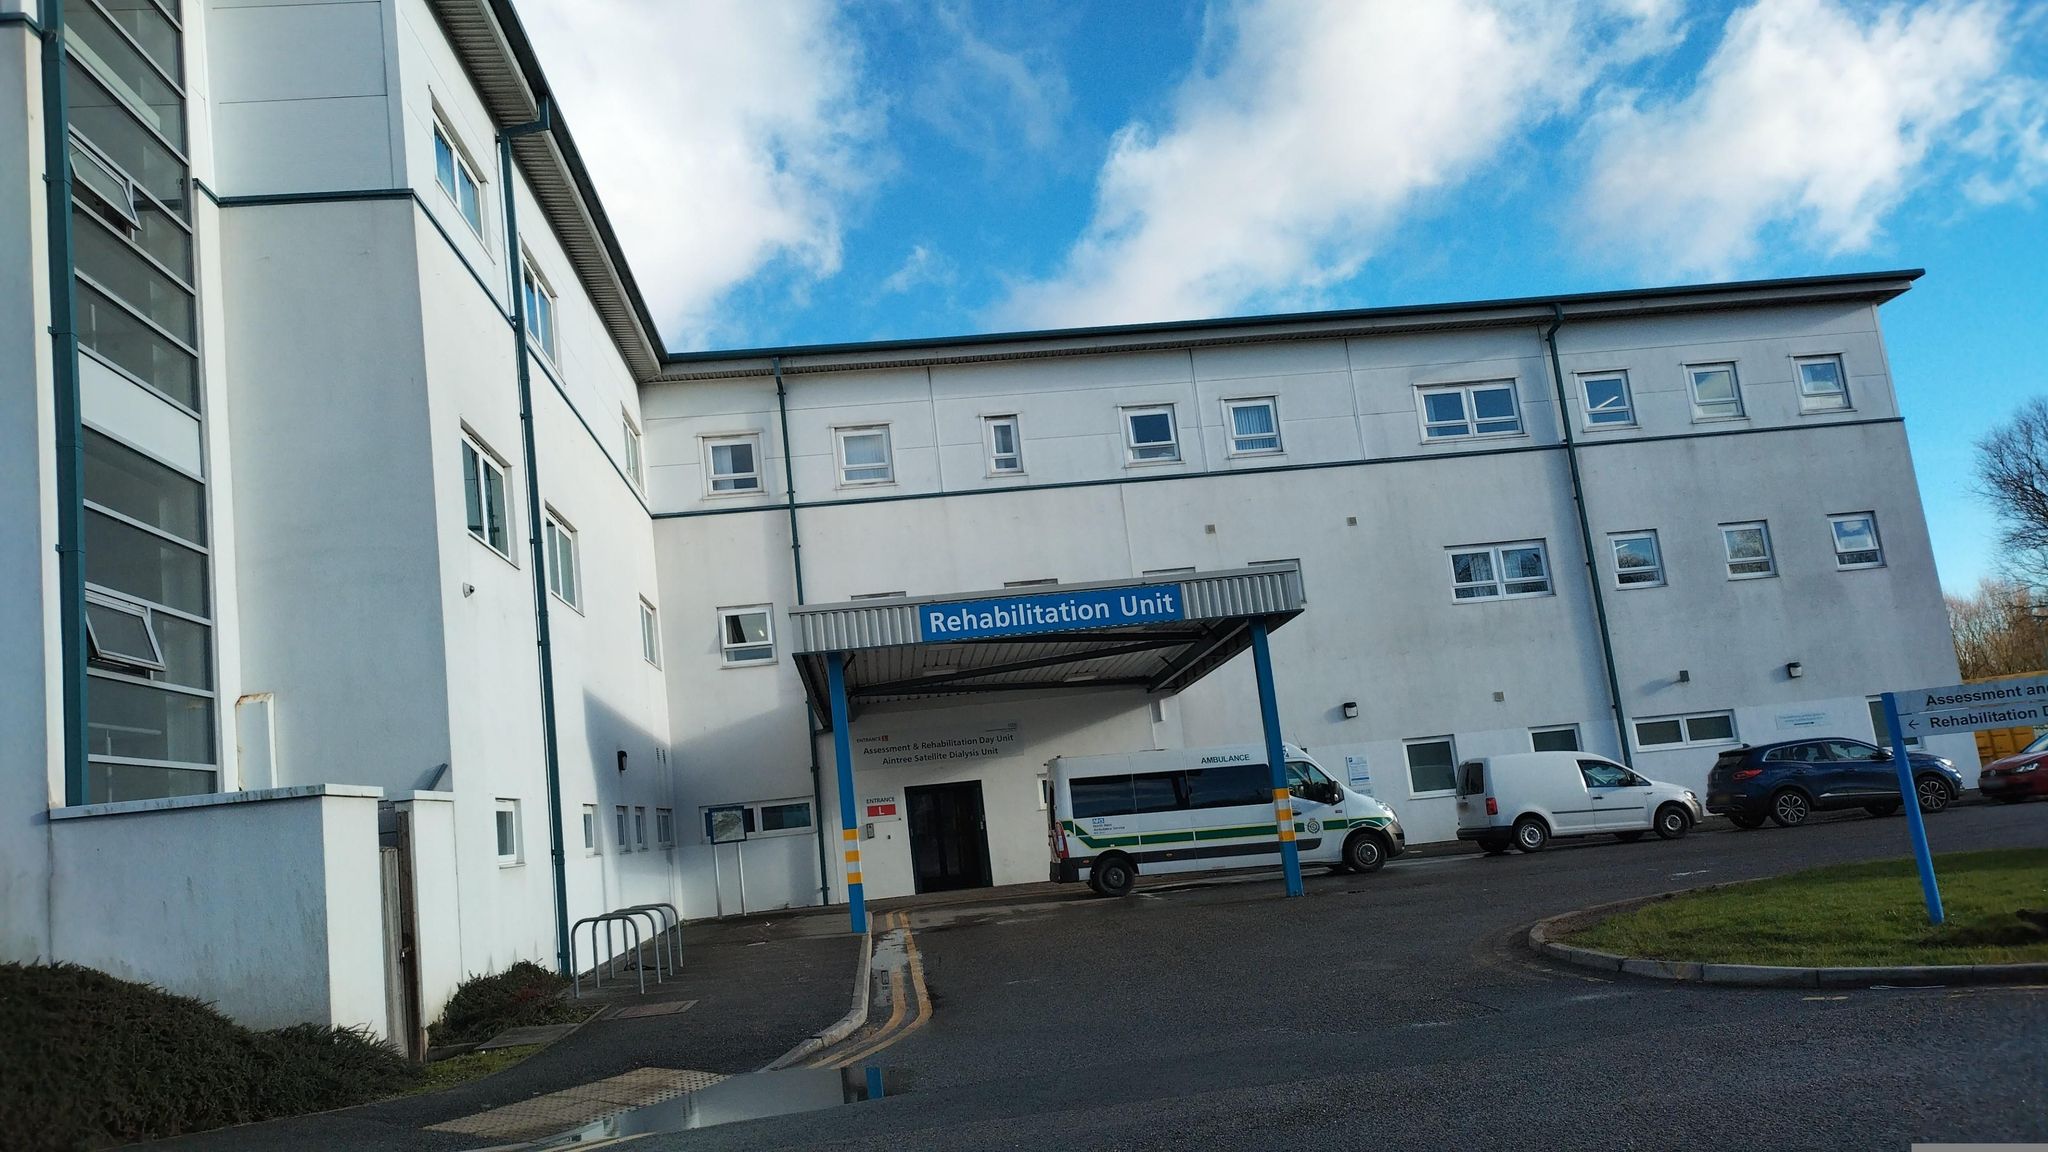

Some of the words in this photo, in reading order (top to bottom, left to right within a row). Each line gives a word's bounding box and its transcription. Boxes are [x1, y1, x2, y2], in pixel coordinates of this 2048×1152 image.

[929, 600, 1110, 633] Rehabilitation
[1120, 592, 1174, 617] Unit
[1926, 686, 2022, 706] Assessment
[2027, 685, 2048, 695] an
[1930, 709, 2038, 728] Rehabilitation
[863, 745, 911, 755] Assessment
[921, 738, 978, 749] Rehabilitation
[979, 735, 995, 745] Day
[996, 733, 1014, 743] Unit
[882, 757, 913, 765] Aintree
[914, 753, 947, 762] Satellite
[949, 750, 979, 759] Dialysis
[981, 747, 999, 756] Unit
[1201, 754, 1249, 764] AMBULANCE
[878, 806, 885, 814] L
